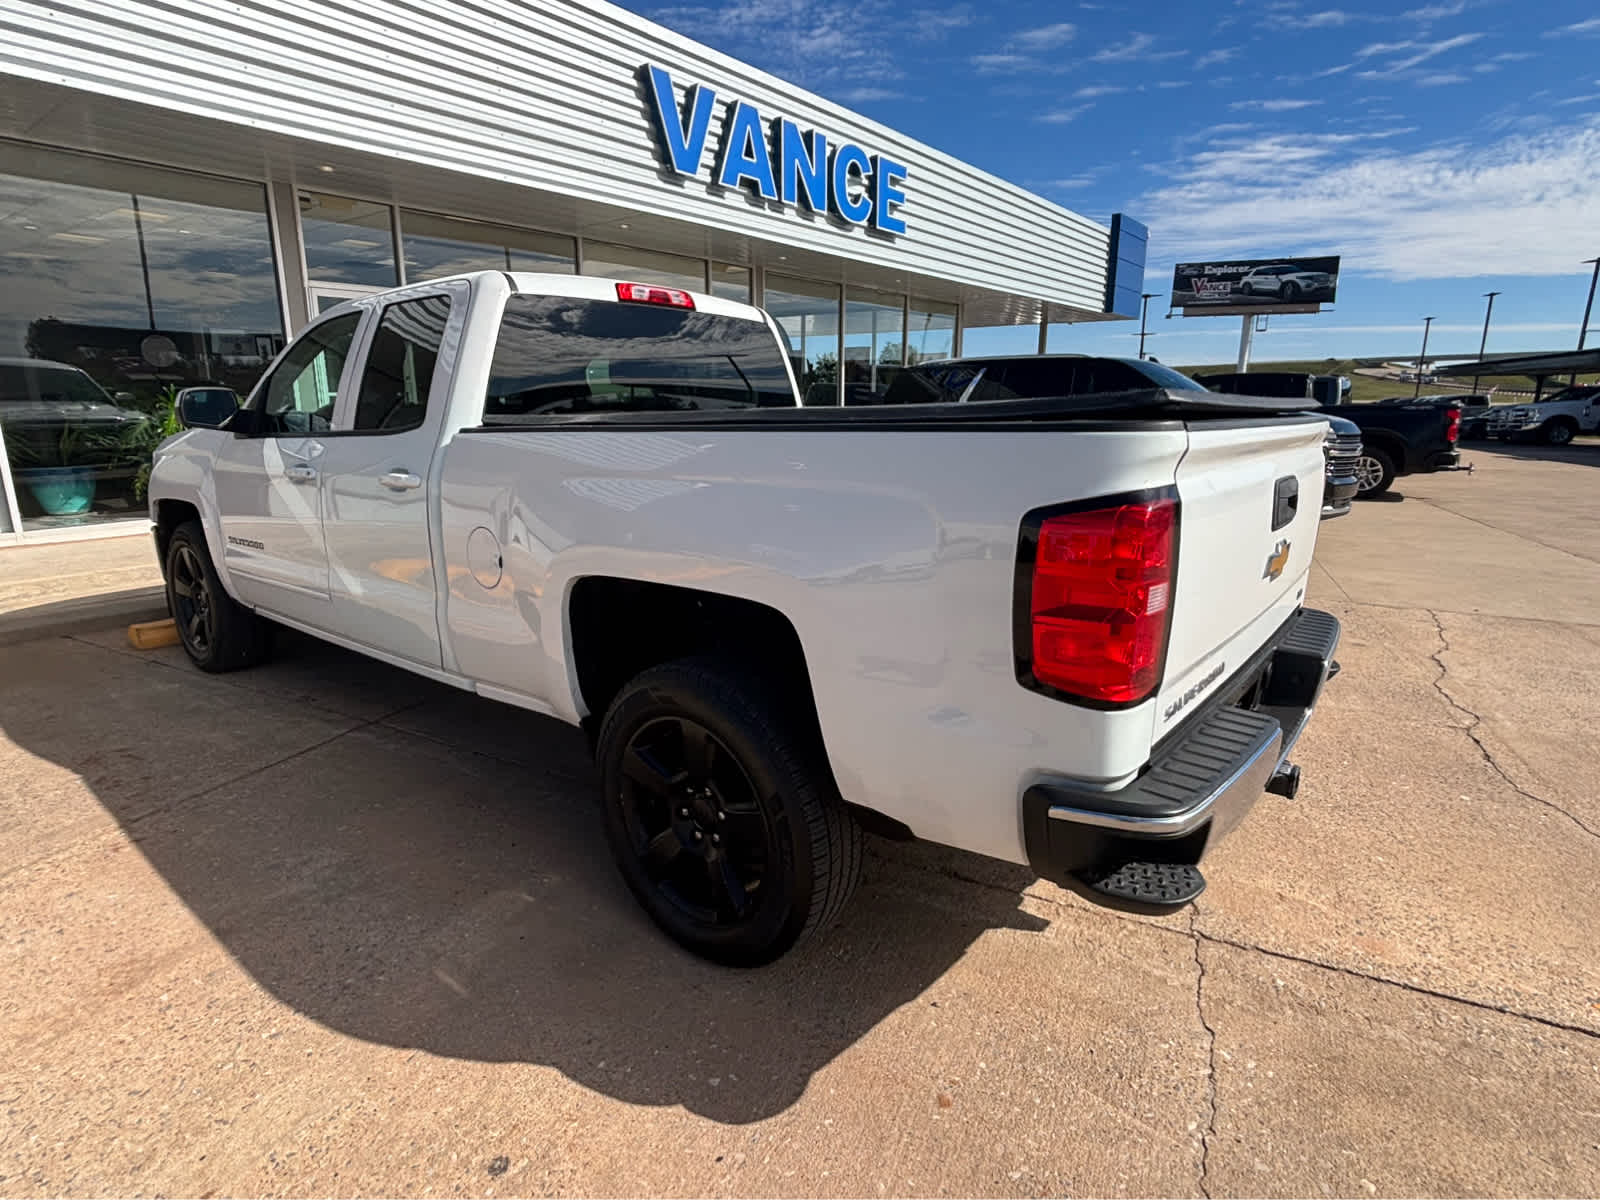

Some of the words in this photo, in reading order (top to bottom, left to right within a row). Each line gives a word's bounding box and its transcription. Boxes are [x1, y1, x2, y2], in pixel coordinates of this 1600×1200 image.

[643, 63, 908, 235] VANCE
[1204, 265, 1250, 275] Explorer
[1191, 277, 1232, 298] VANCE
